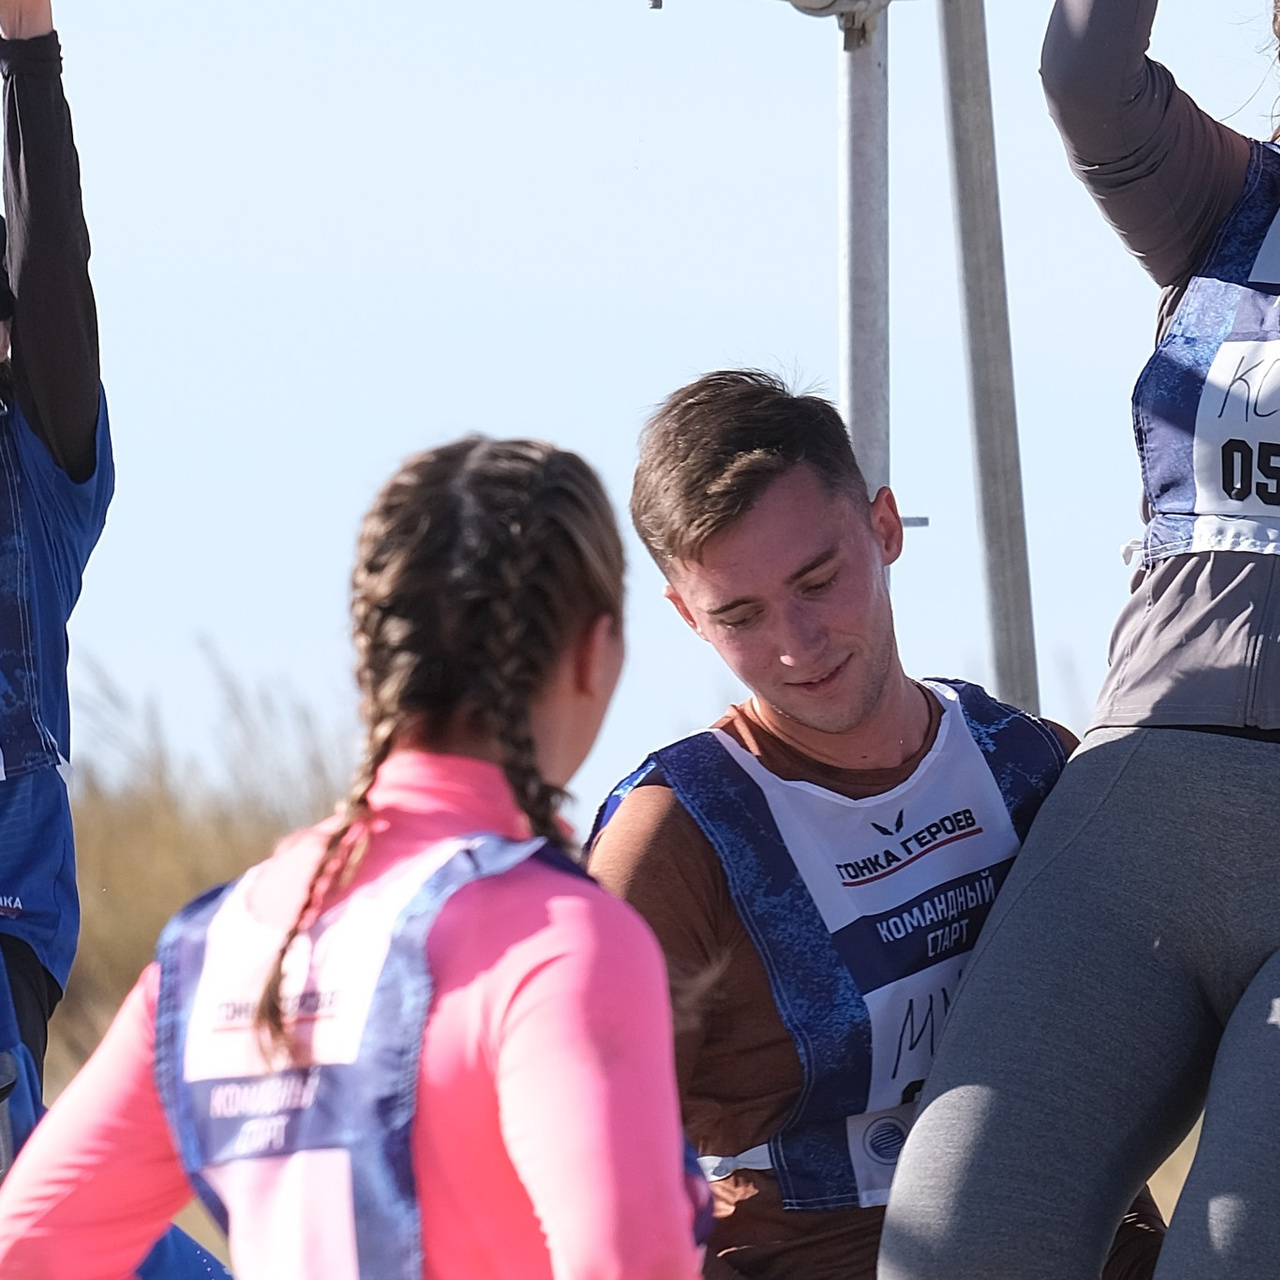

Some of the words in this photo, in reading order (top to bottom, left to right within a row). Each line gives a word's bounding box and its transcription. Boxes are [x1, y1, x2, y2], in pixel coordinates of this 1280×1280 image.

[835, 849, 902, 881] ГОНКА
[900, 808, 976, 856] ГЕРОЕВ
[0, 895, 23, 910] КА
[876, 870, 995, 943] КОМАНДНЫЙ
[927, 919, 969, 958] СТАРТ
